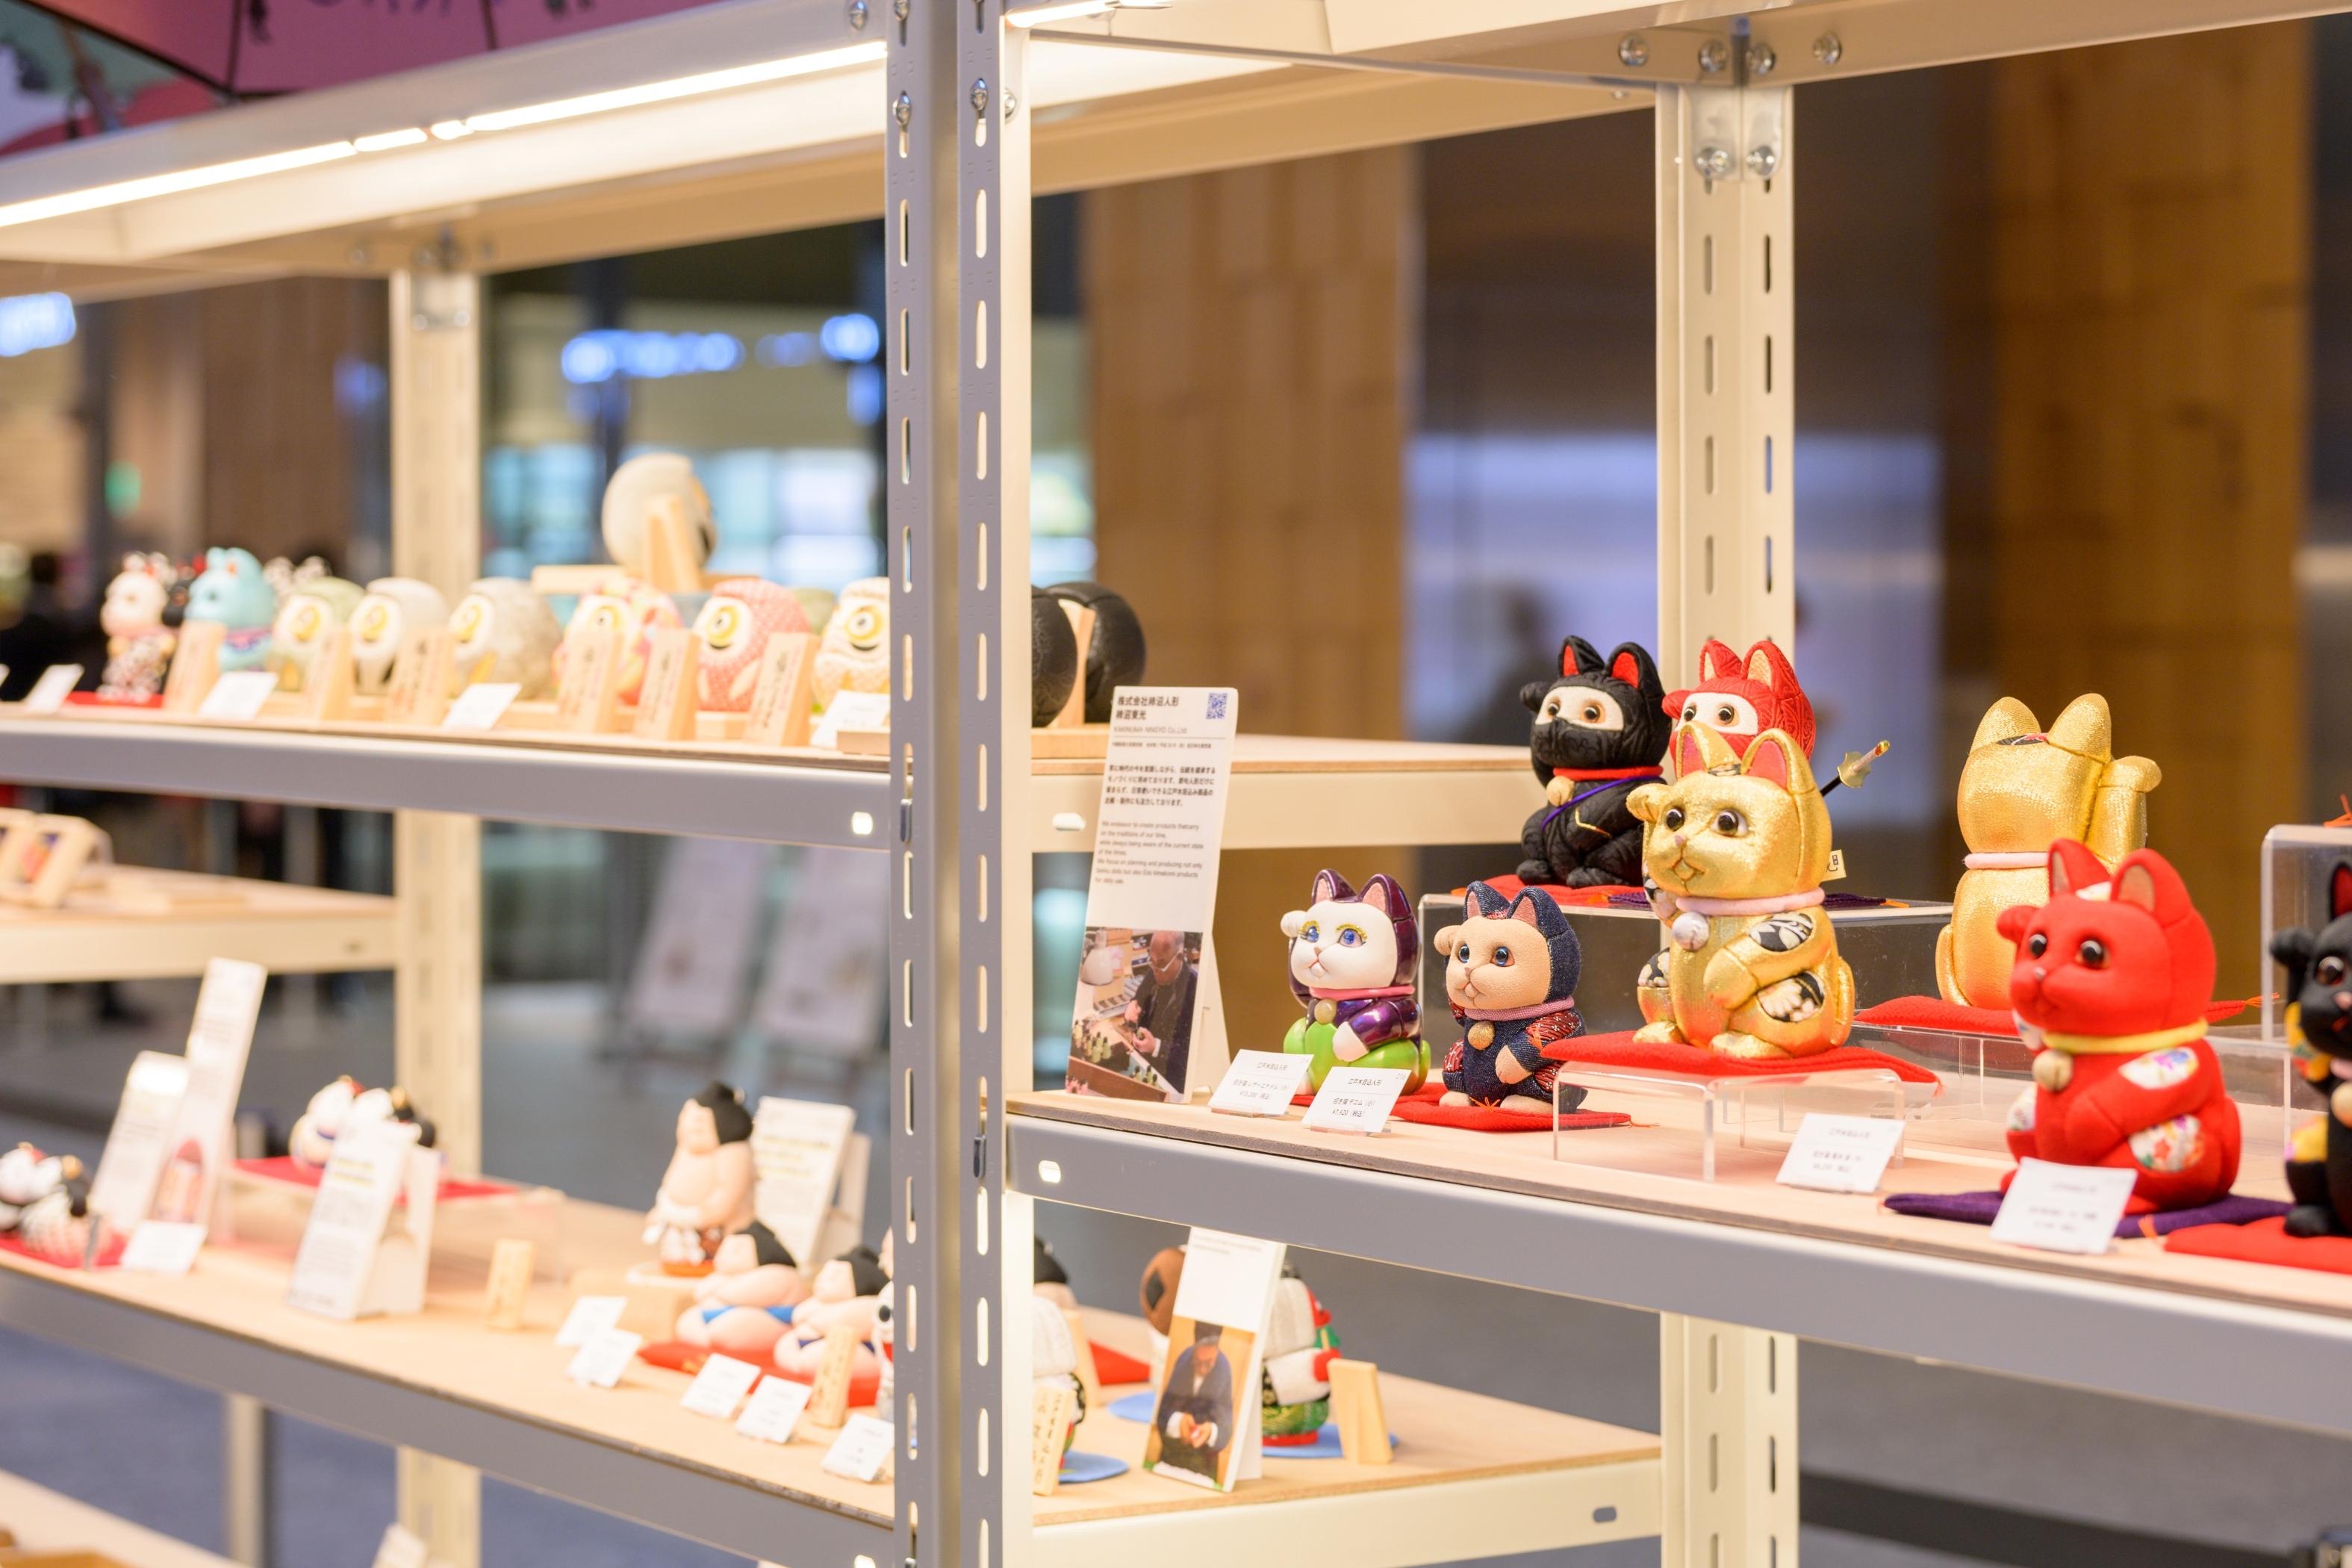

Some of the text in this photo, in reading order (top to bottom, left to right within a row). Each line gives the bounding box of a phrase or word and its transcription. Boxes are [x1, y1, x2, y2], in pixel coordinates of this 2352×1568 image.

[1257, 1063, 1288, 1071] 江戸木目込人形
